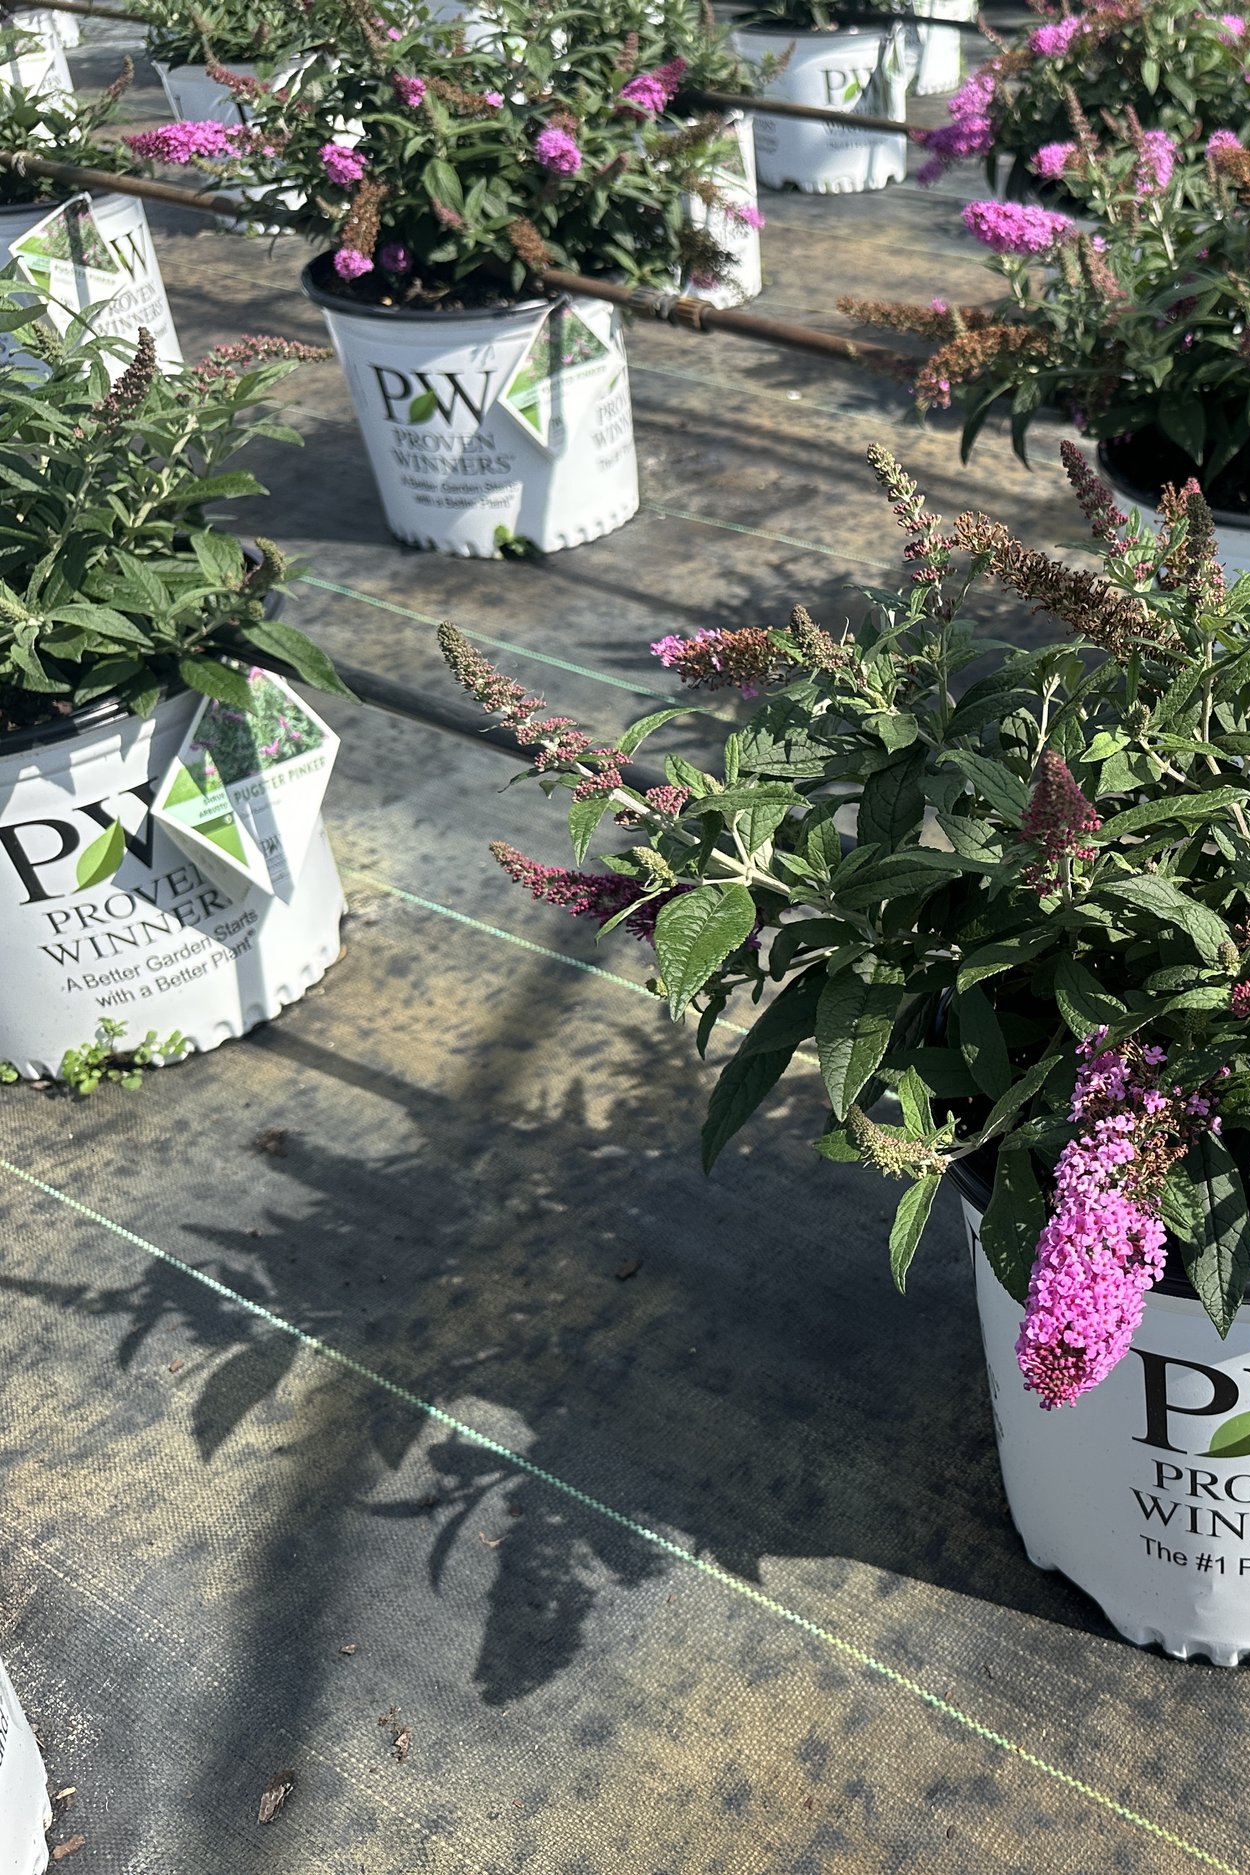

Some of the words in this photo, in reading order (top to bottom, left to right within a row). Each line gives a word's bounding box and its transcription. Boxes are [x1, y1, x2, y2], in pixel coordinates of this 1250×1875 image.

[368, 361, 498, 428] PW
[391, 427, 496, 453] PROVEN
[234, 774, 286, 803] PUGSTER
[289, 757, 325, 779] PINKER
[38, 889, 234, 968] WINNER
[66, 976, 83, 994] A
[82, 963, 141, 990] Better
[146, 936, 213, 973] Garden
[213, 909, 259, 942] Starts
[96, 987, 136, 1009] with
[141, 985, 154, 999] a
[154, 961, 209, 994] Better
[1140, 1534, 1188, 1566] The
[1195, 1553, 1226, 1575] #1
